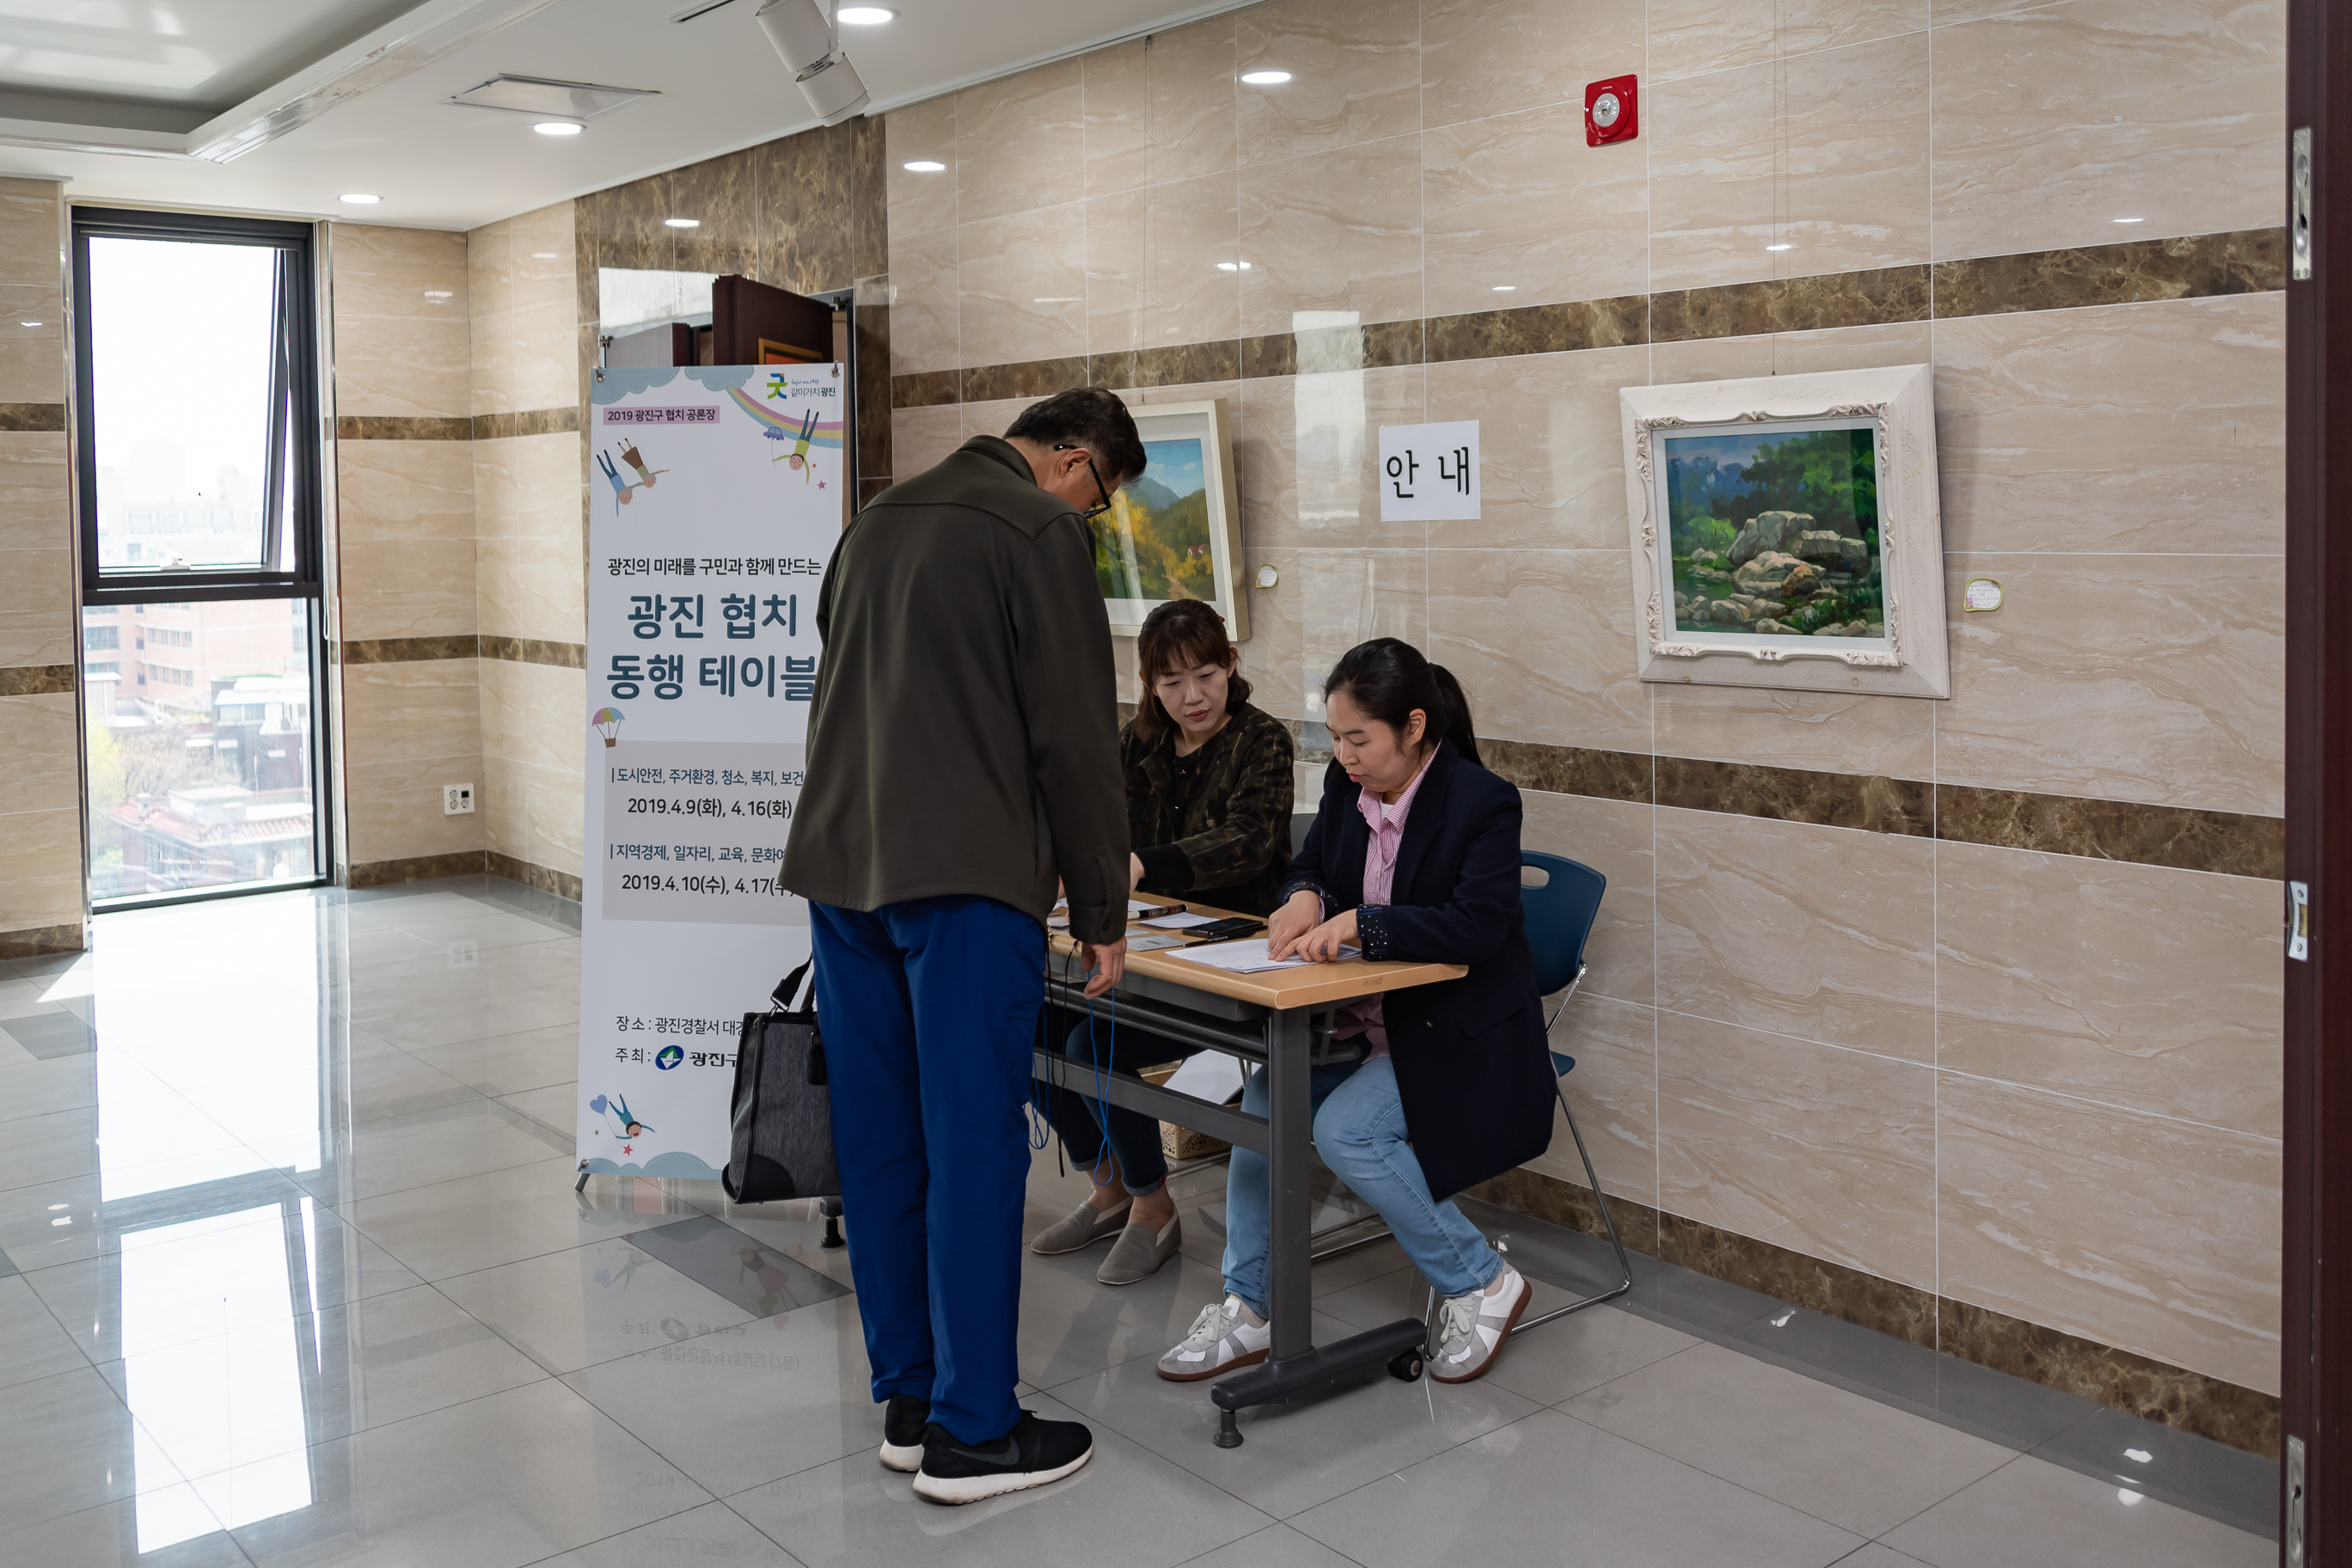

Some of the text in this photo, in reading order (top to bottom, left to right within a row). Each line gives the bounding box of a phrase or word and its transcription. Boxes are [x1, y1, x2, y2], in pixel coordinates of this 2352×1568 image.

[608, 408, 715, 421] 2019 광진구 협치 공론장
[608, 558, 822, 576] 광진의 미래를 구민과 함께 만드는
[628, 593, 796, 639] 광진 협치
[607, 654, 816, 701] 동행 테이블
[617, 768, 803, 787] 도시안전, 주거환경, 청소, 복지, 보건
[628, 799, 793, 819] 2019.4.9(화), 4.16(화)
[616, 844, 670, 861] 지역경제,
[674, 846, 714, 862] 일자리,
[719, 847, 747, 863] 교육,
[622, 874, 794, 897] 2019.4.10(수), 4.17(수
[655, 1018, 719, 1035] 광진경찰서
